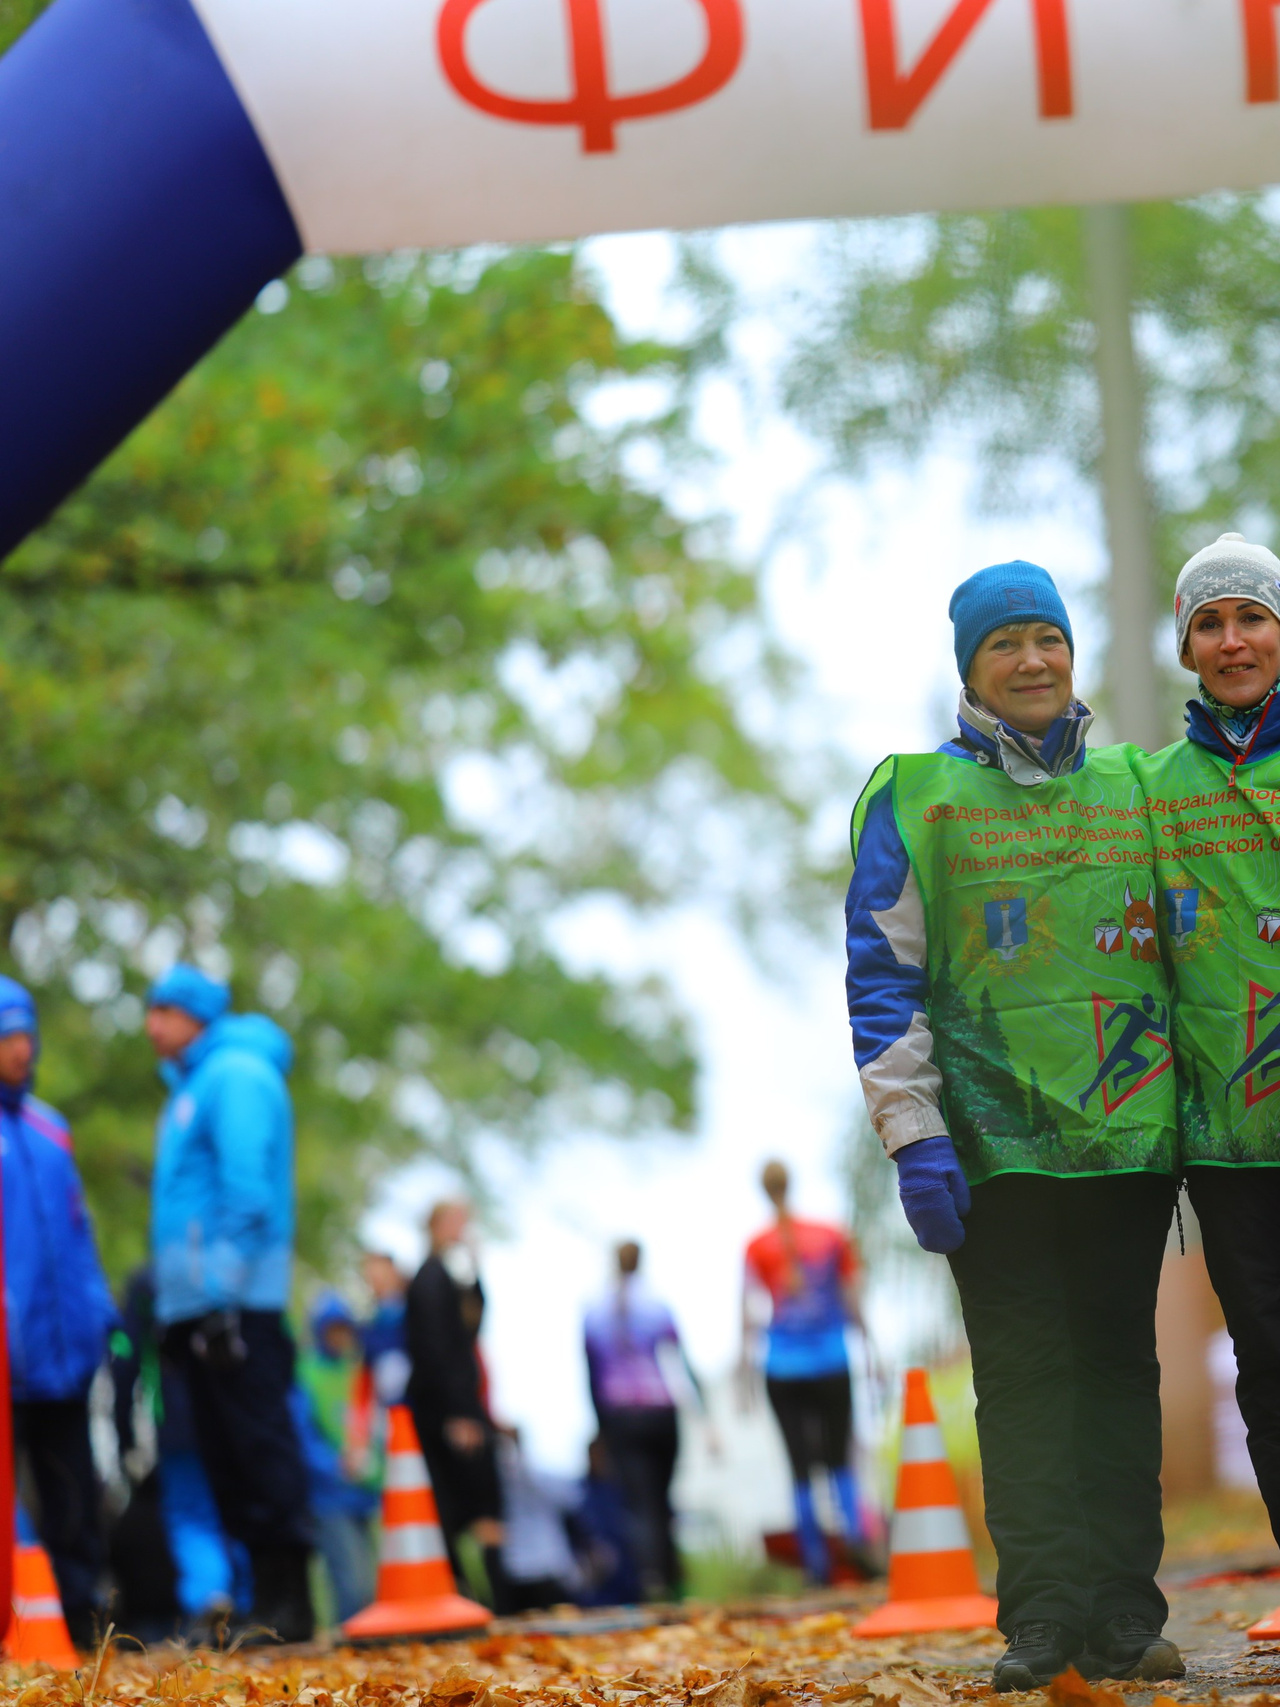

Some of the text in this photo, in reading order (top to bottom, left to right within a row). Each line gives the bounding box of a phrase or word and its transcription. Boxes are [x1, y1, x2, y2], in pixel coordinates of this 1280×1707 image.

[923, 800, 1150, 825] Федерация спортивно
[1146, 789, 1239, 816] едерация
[970, 825, 1145, 849] ориентирования
[946, 846, 1155, 875] Ульяновской облас
